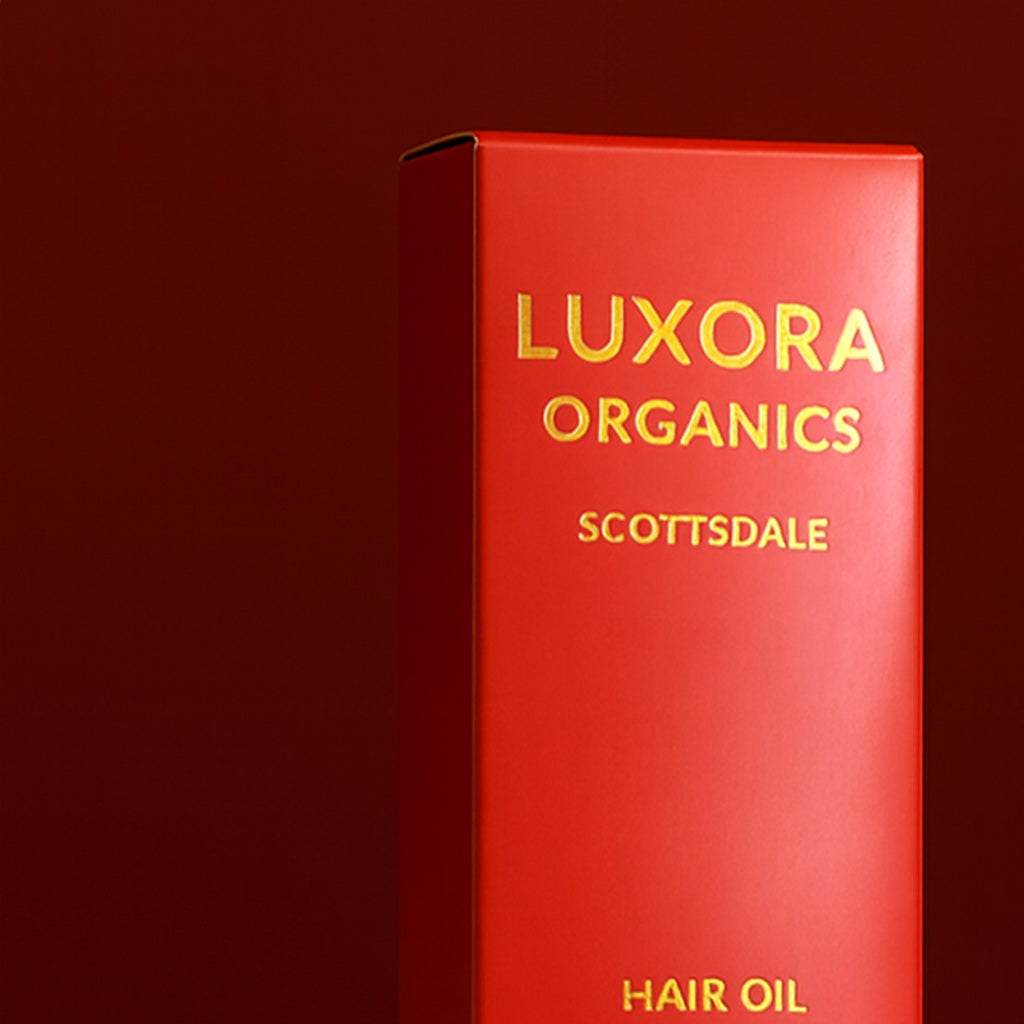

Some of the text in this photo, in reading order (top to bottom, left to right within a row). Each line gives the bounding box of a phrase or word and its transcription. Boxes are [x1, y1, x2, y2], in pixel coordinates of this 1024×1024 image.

[517, 293, 885, 373] LUXORA
[543, 395, 861, 454] ORGANICS
[578, 511, 829, 551] SCOTTSDALE
[622, 978, 807, 1013] HAIR OIL
